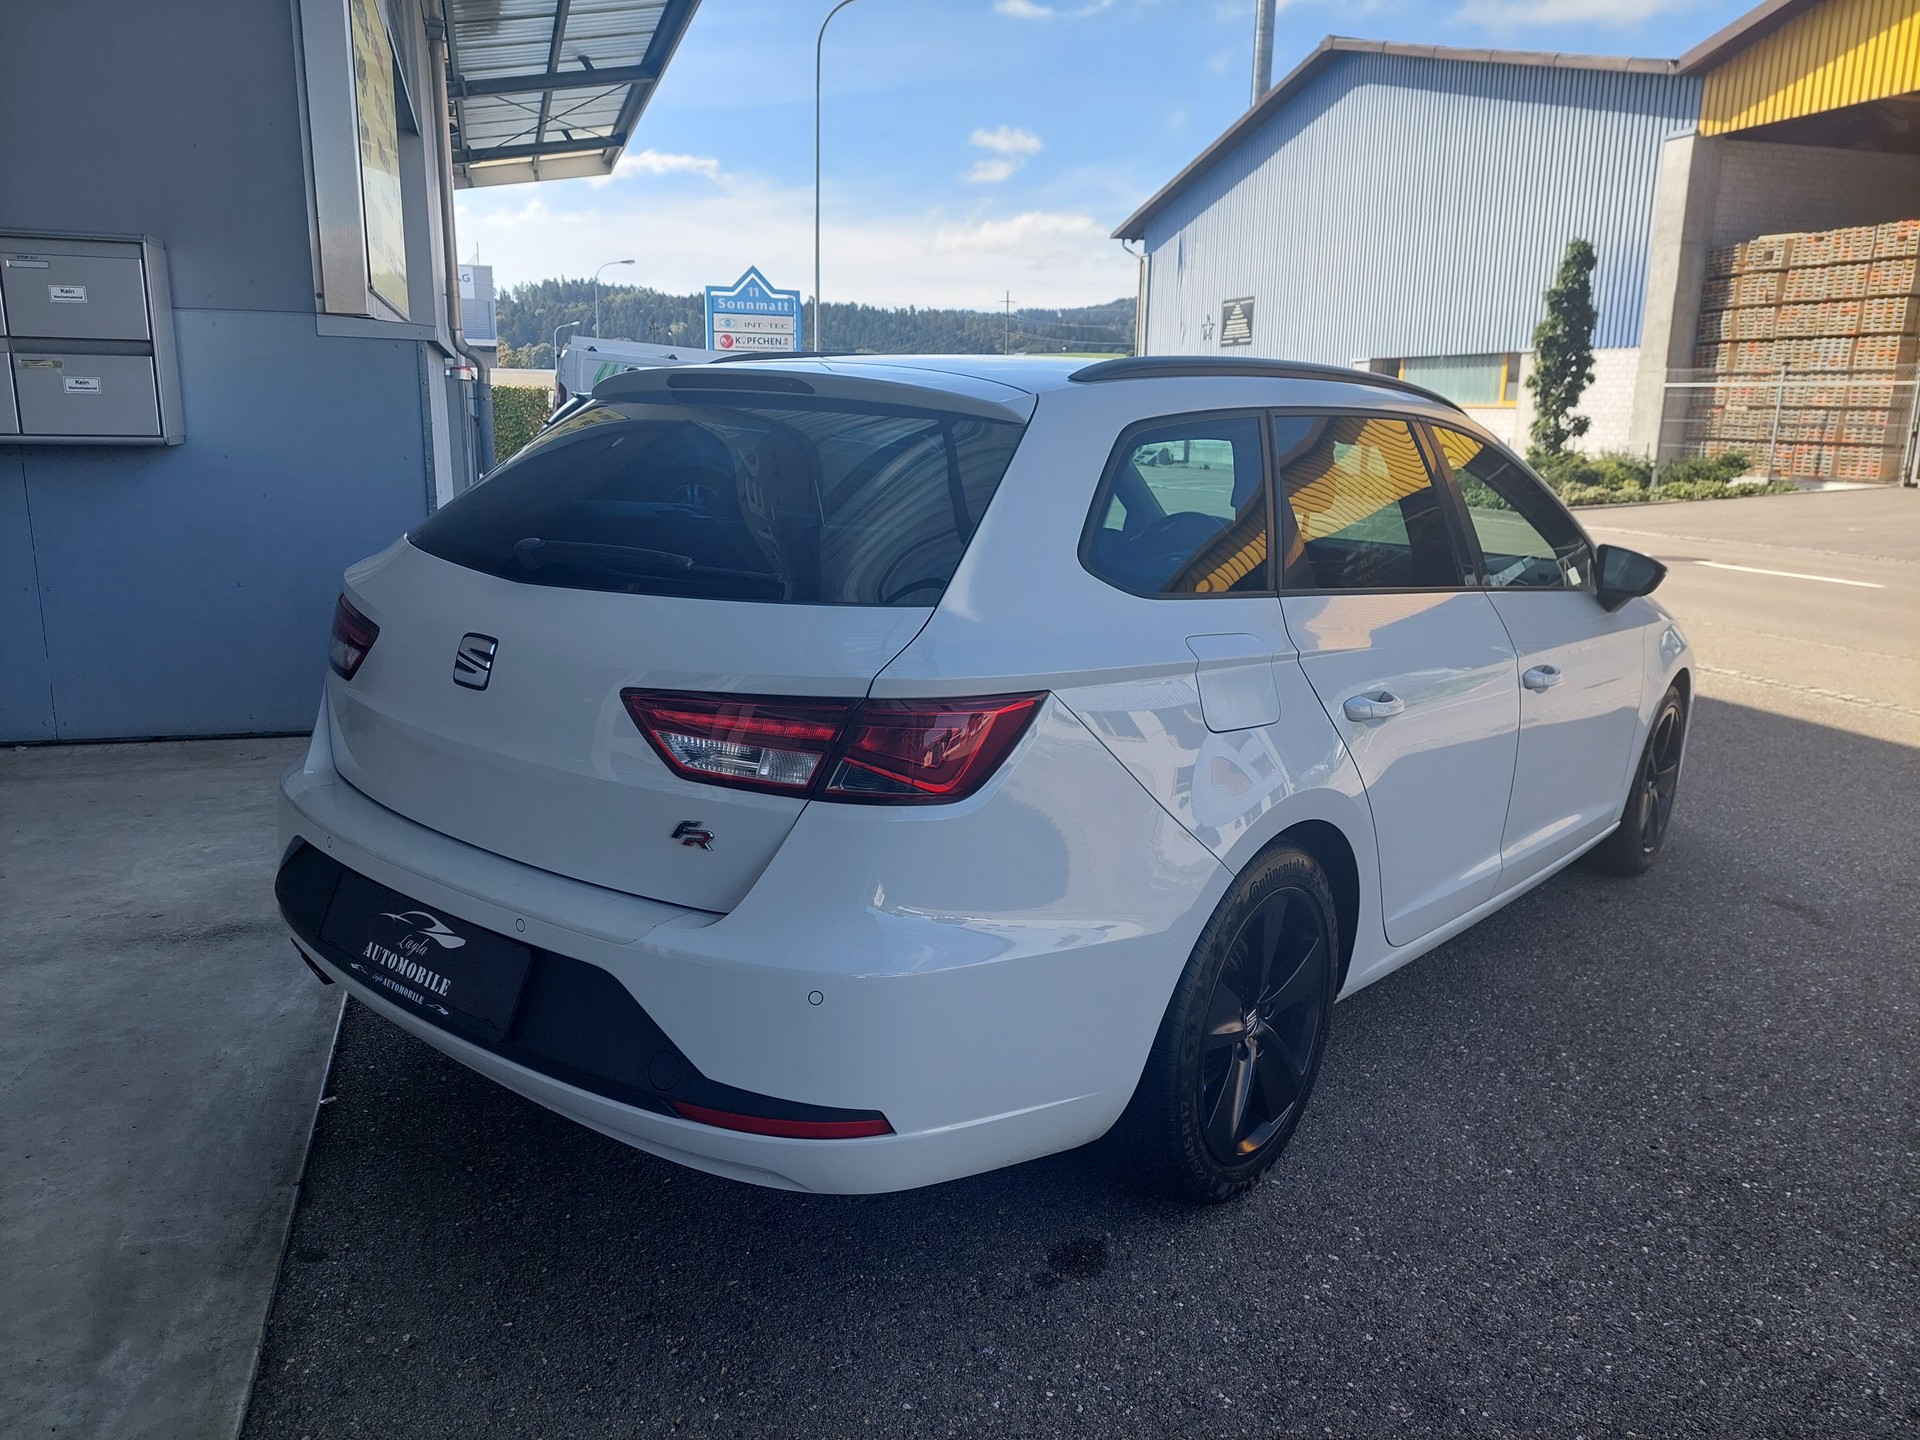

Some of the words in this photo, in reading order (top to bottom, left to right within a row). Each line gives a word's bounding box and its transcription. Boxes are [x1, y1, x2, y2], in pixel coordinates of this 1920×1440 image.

[718, 297, 789, 311] Sonnmatt
[747, 287, 759, 297] 11
[670, 820, 715, 851] FR
[397, 934, 429, 957] Layla
[363, 941, 452, 997] AUTOMOBILE
[382, 977, 425, 1005] AUTOMOBILE
